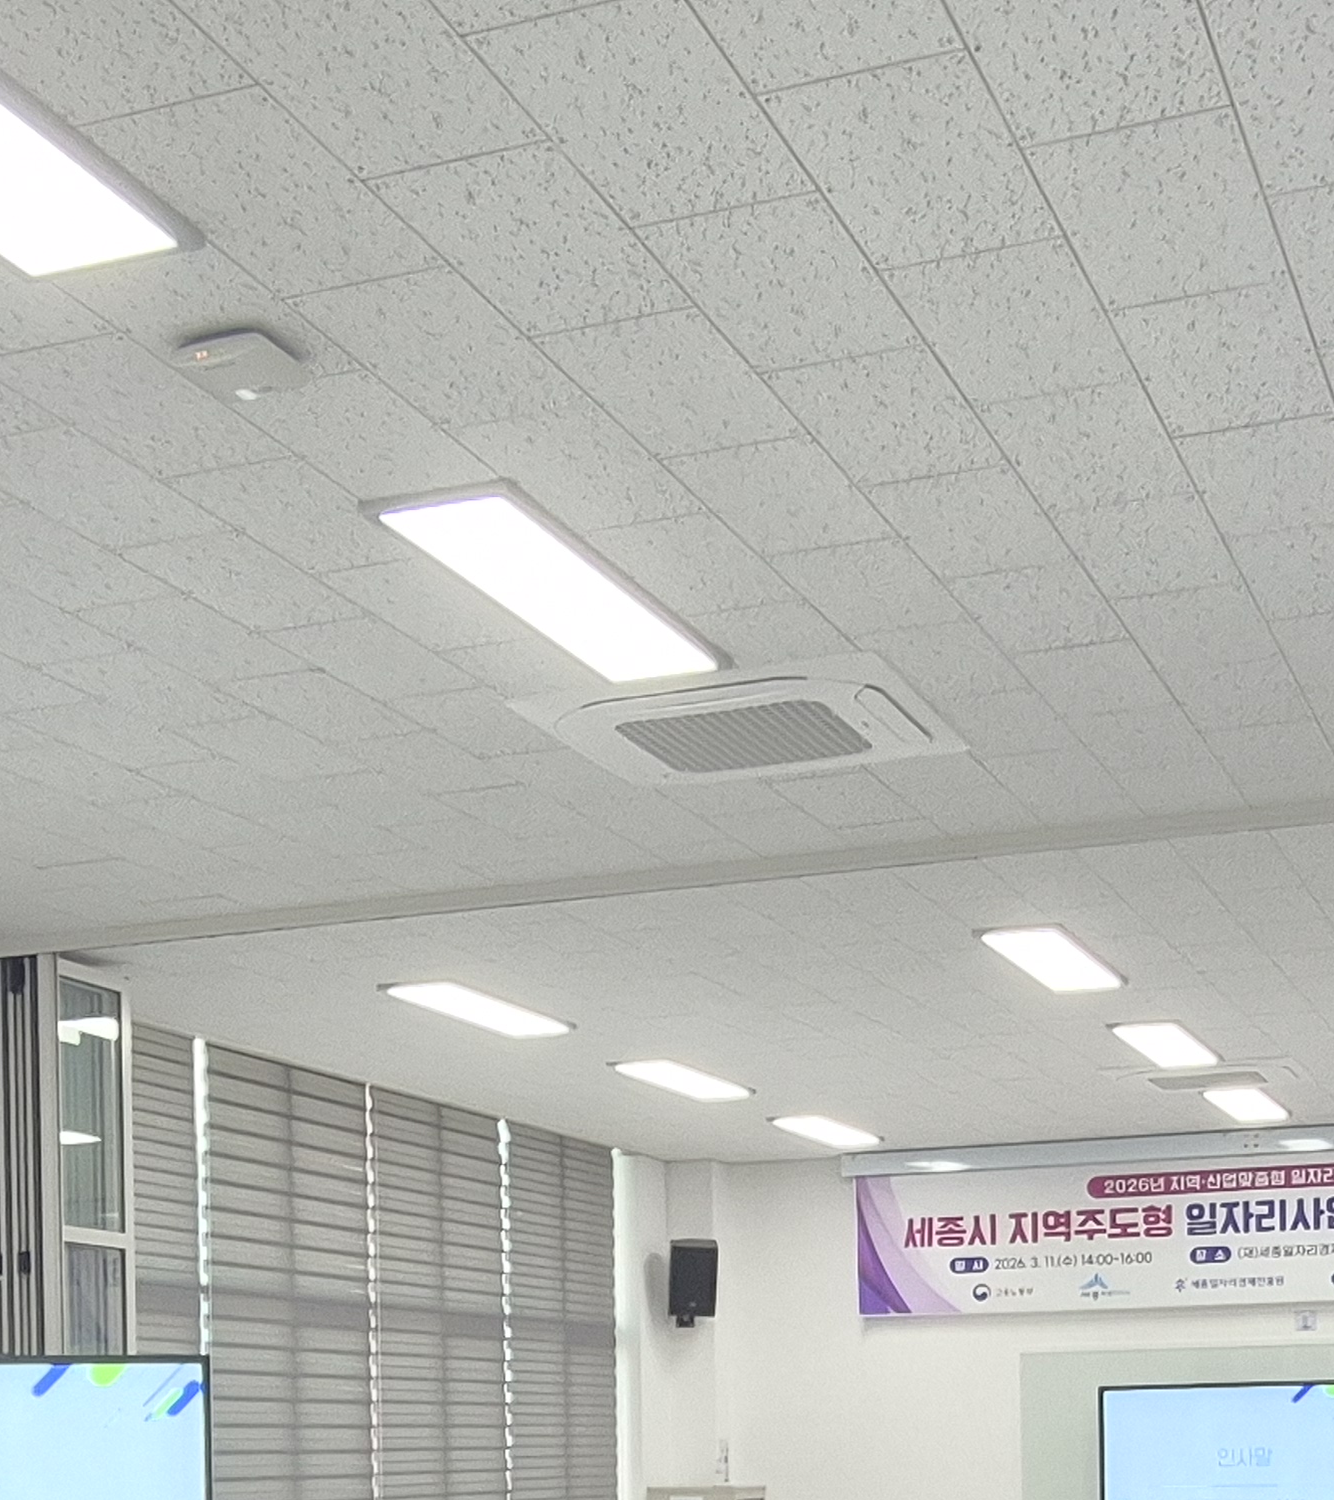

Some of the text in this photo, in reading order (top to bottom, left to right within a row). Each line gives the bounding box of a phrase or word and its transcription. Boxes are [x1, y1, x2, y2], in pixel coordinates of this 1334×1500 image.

[1103, 1176, 1165, 1194] 2026년
[904, 1213, 997, 1248] 세종시
[1008, 1203, 1174, 1244] 지역주도형
[1217, 1447, 1273, 1467] 인사말
